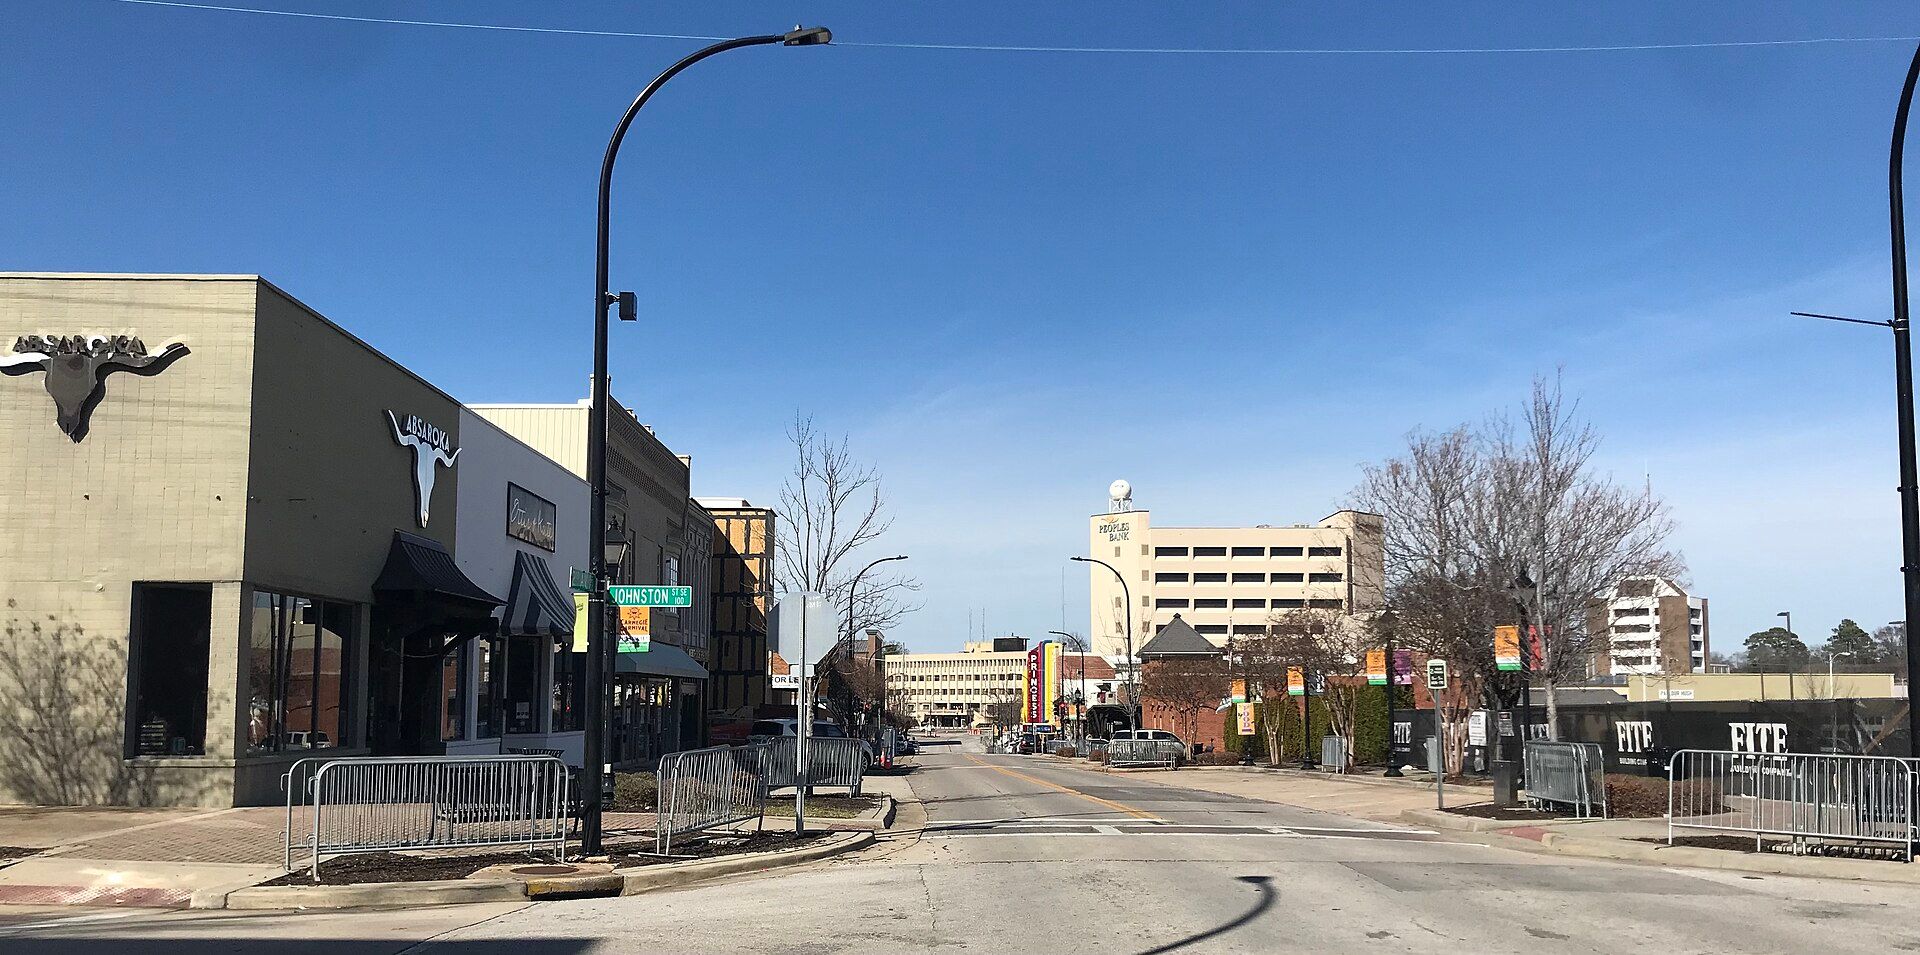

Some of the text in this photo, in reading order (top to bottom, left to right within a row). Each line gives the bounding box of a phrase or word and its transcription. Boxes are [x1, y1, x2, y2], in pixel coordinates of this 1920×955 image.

[12, 335, 148, 356] ABSAROKA
[406, 414, 450, 452] ABSAROKA
[1099, 522, 1130, 533] PEOPLES
[1109, 532, 1130, 541] BANK
[614, 588, 688, 604] JOHNSTON ST SE
[674, 596, 685, 604] 100
[1030, 654, 1038, 719] PRINCESS
[1242, 705, 1251, 728] FOOD
[1615, 721, 1655, 752] FITE
[1728, 722, 1788, 761] FITE
